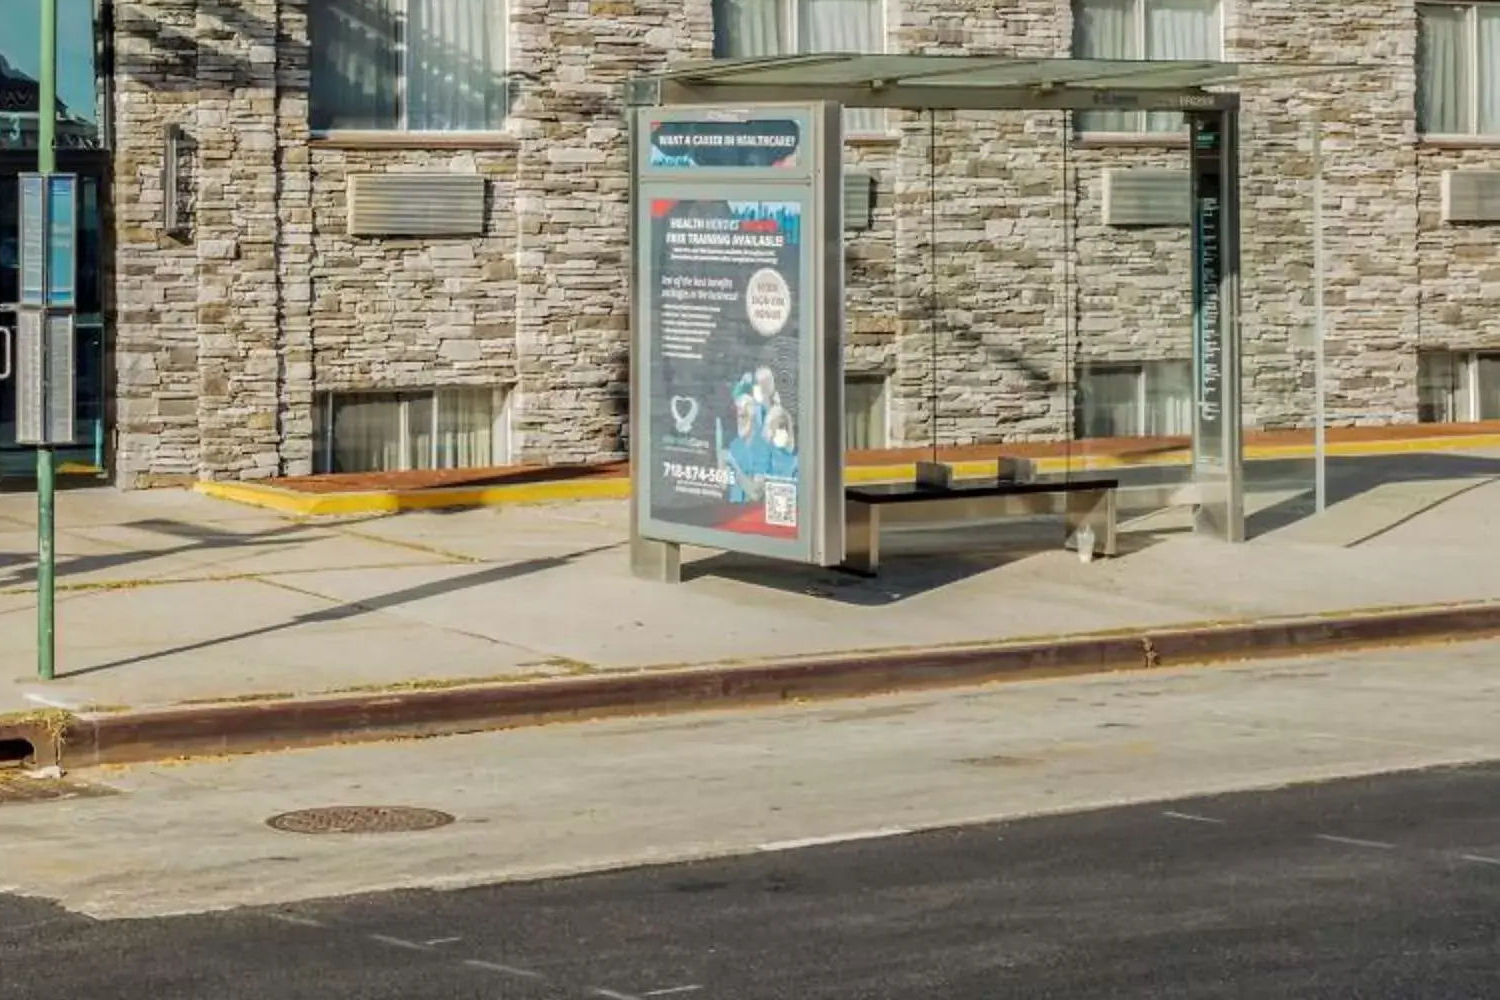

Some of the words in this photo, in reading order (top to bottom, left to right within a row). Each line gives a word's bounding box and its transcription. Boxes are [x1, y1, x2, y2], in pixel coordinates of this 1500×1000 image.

[658, 135, 683, 145] WANT
[693, 135, 723, 145] CAREER
[670, 217, 704, 229] HEALTH
[688, 232, 731, 245] TRAINING
